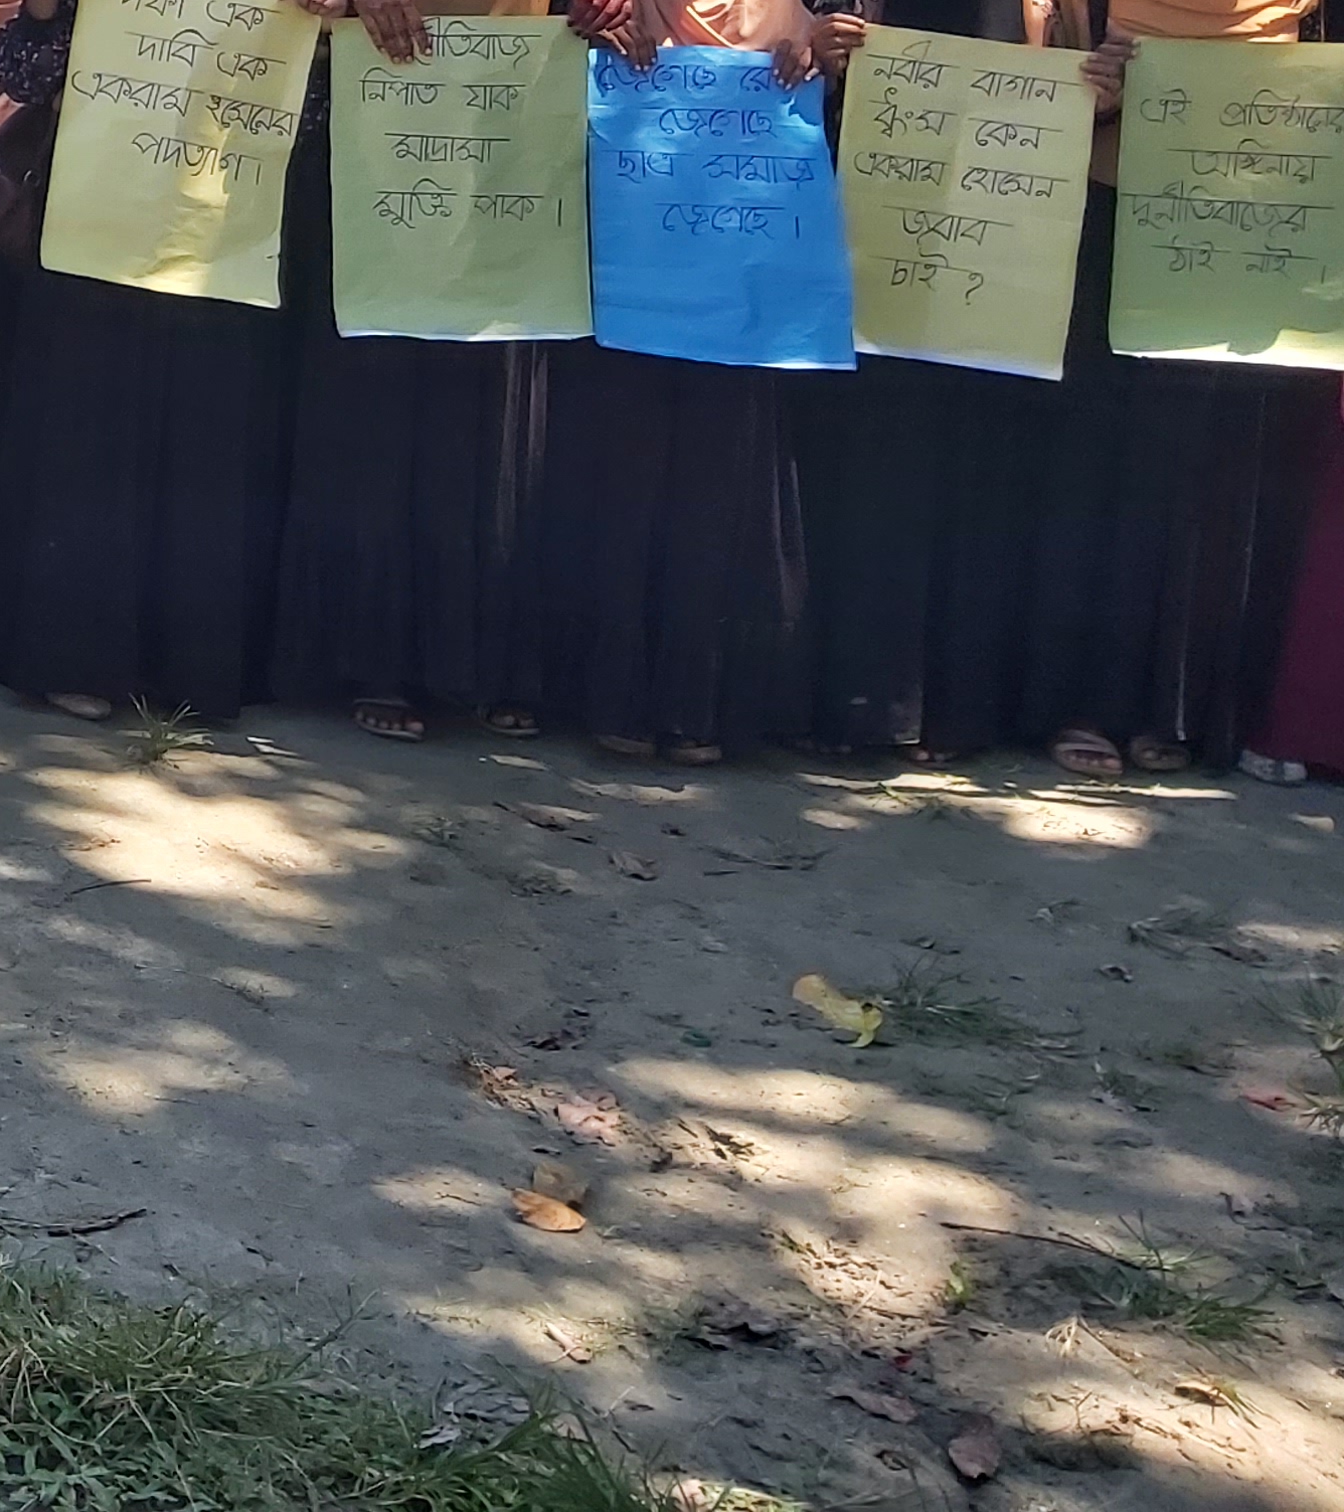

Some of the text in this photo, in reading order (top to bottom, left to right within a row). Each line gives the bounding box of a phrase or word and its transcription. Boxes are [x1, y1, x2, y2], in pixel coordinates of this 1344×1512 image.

[206, 0, 281, 31] এক
[217, 52, 287, 81] এক
[72, 70, 205, 117] একরাম
[359, 67, 526, 111] নিপাত যাক
[854, 151, 951, 186] একরাম
